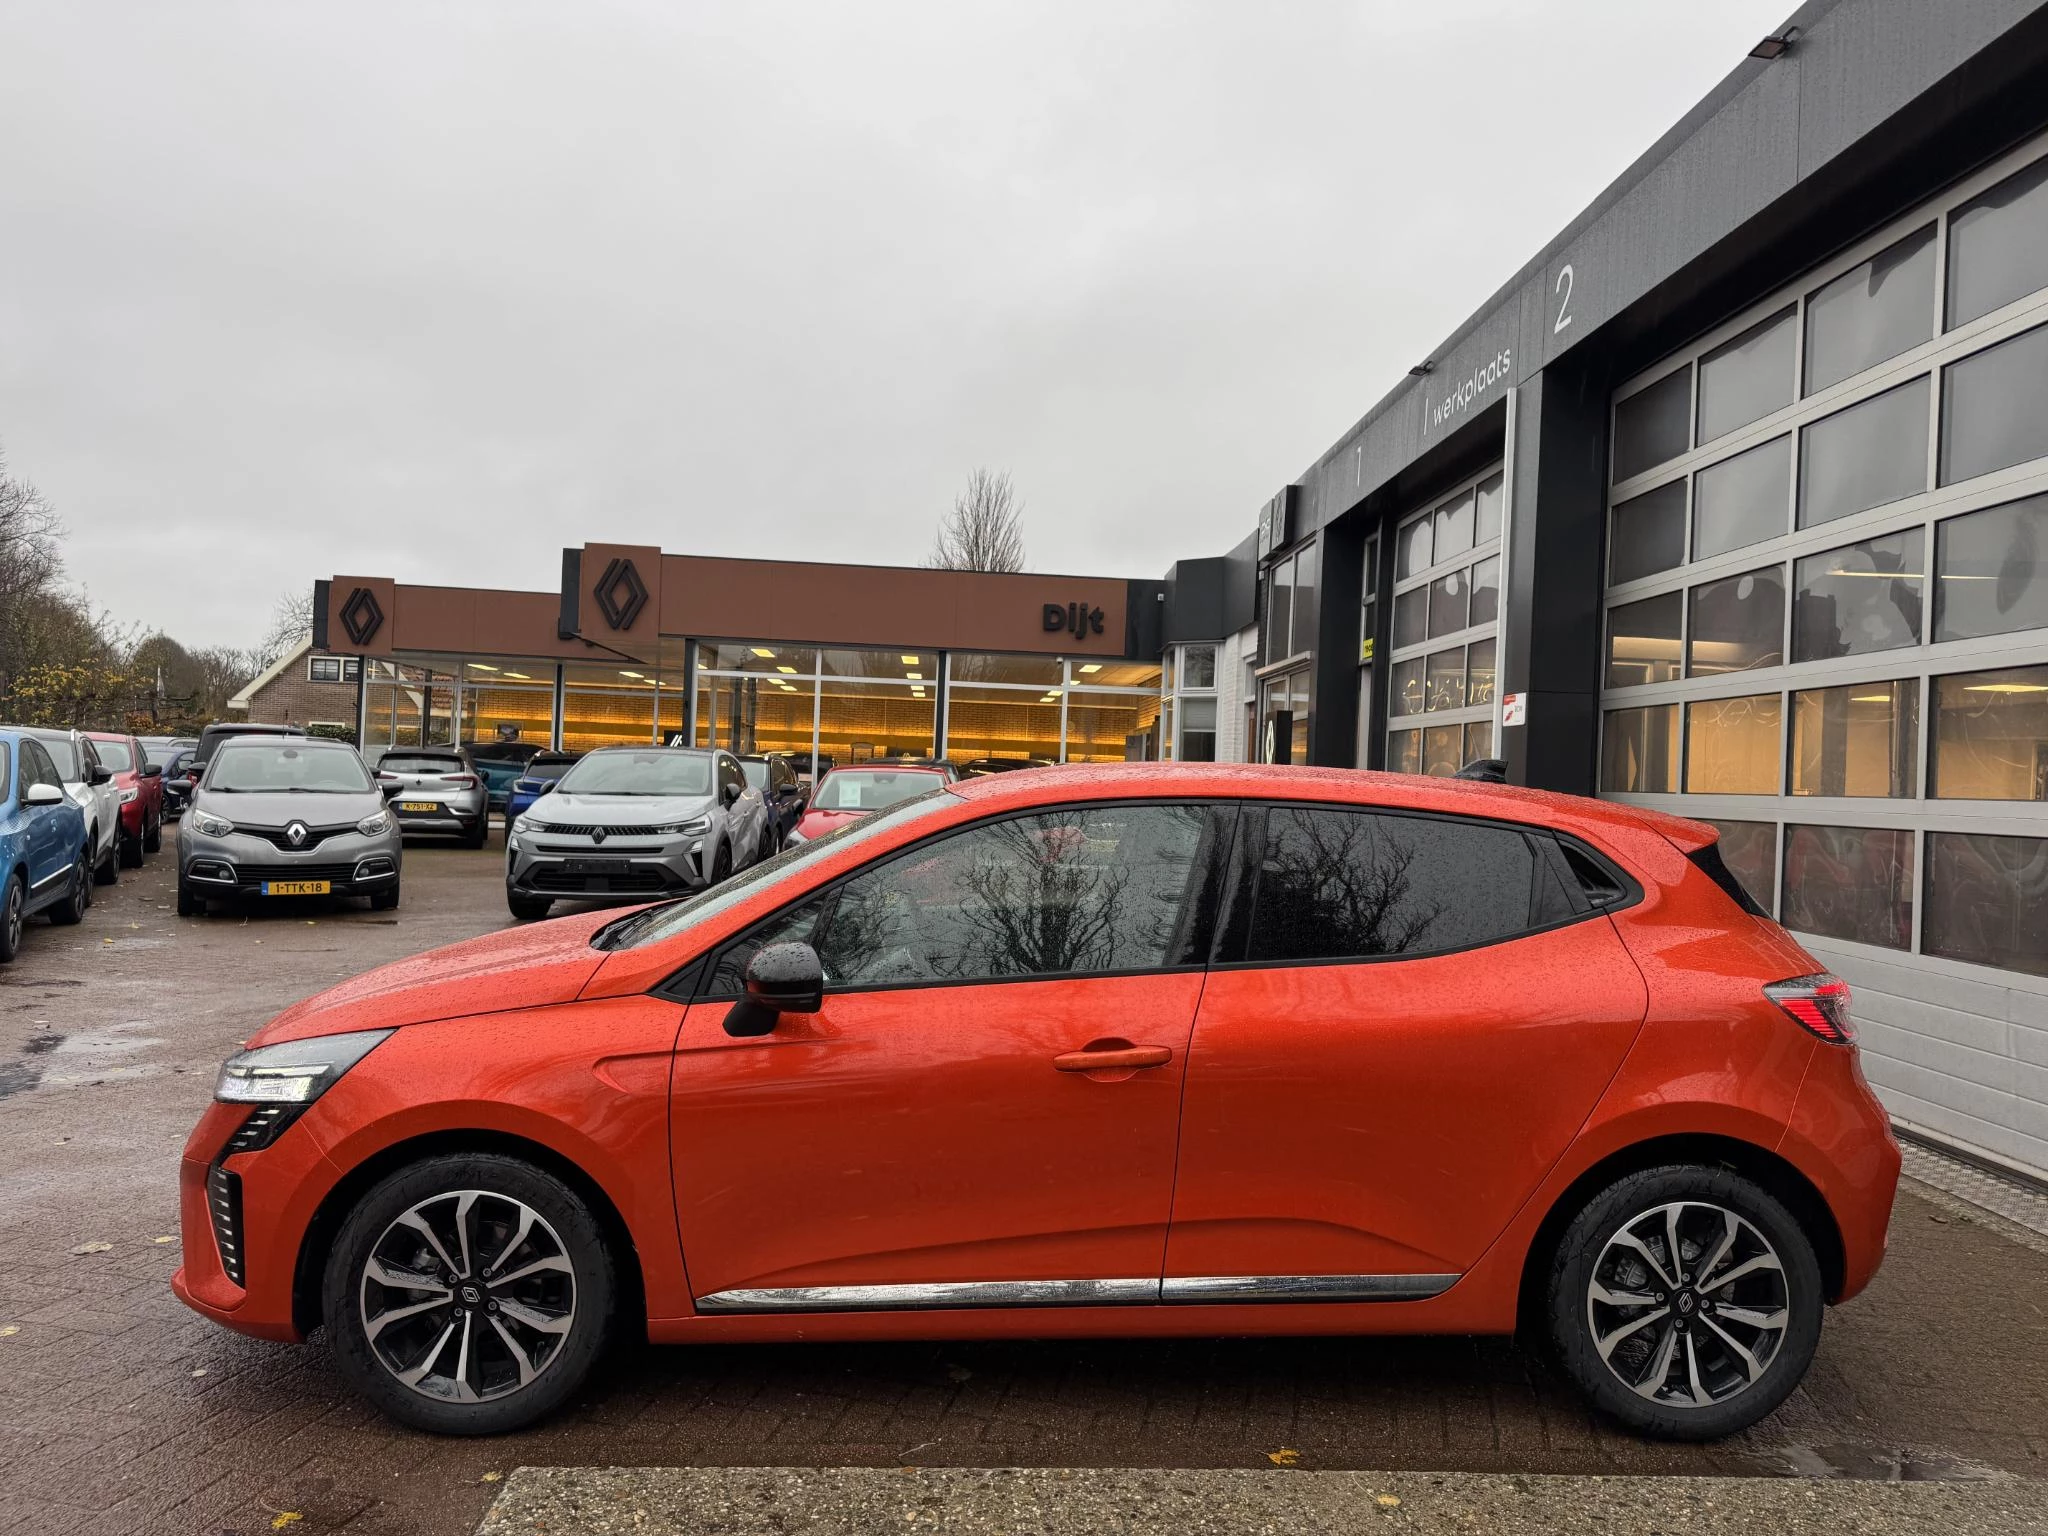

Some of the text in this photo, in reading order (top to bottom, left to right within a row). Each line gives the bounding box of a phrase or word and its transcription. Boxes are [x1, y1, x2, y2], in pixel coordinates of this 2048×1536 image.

[1554, 264, 1574, 334] 2
[1433, 348, 1511, 427] werkplaats
[1043, 602, 1105, 640] Dijt
[275, 883, 322, 894] 1-TTK-18
